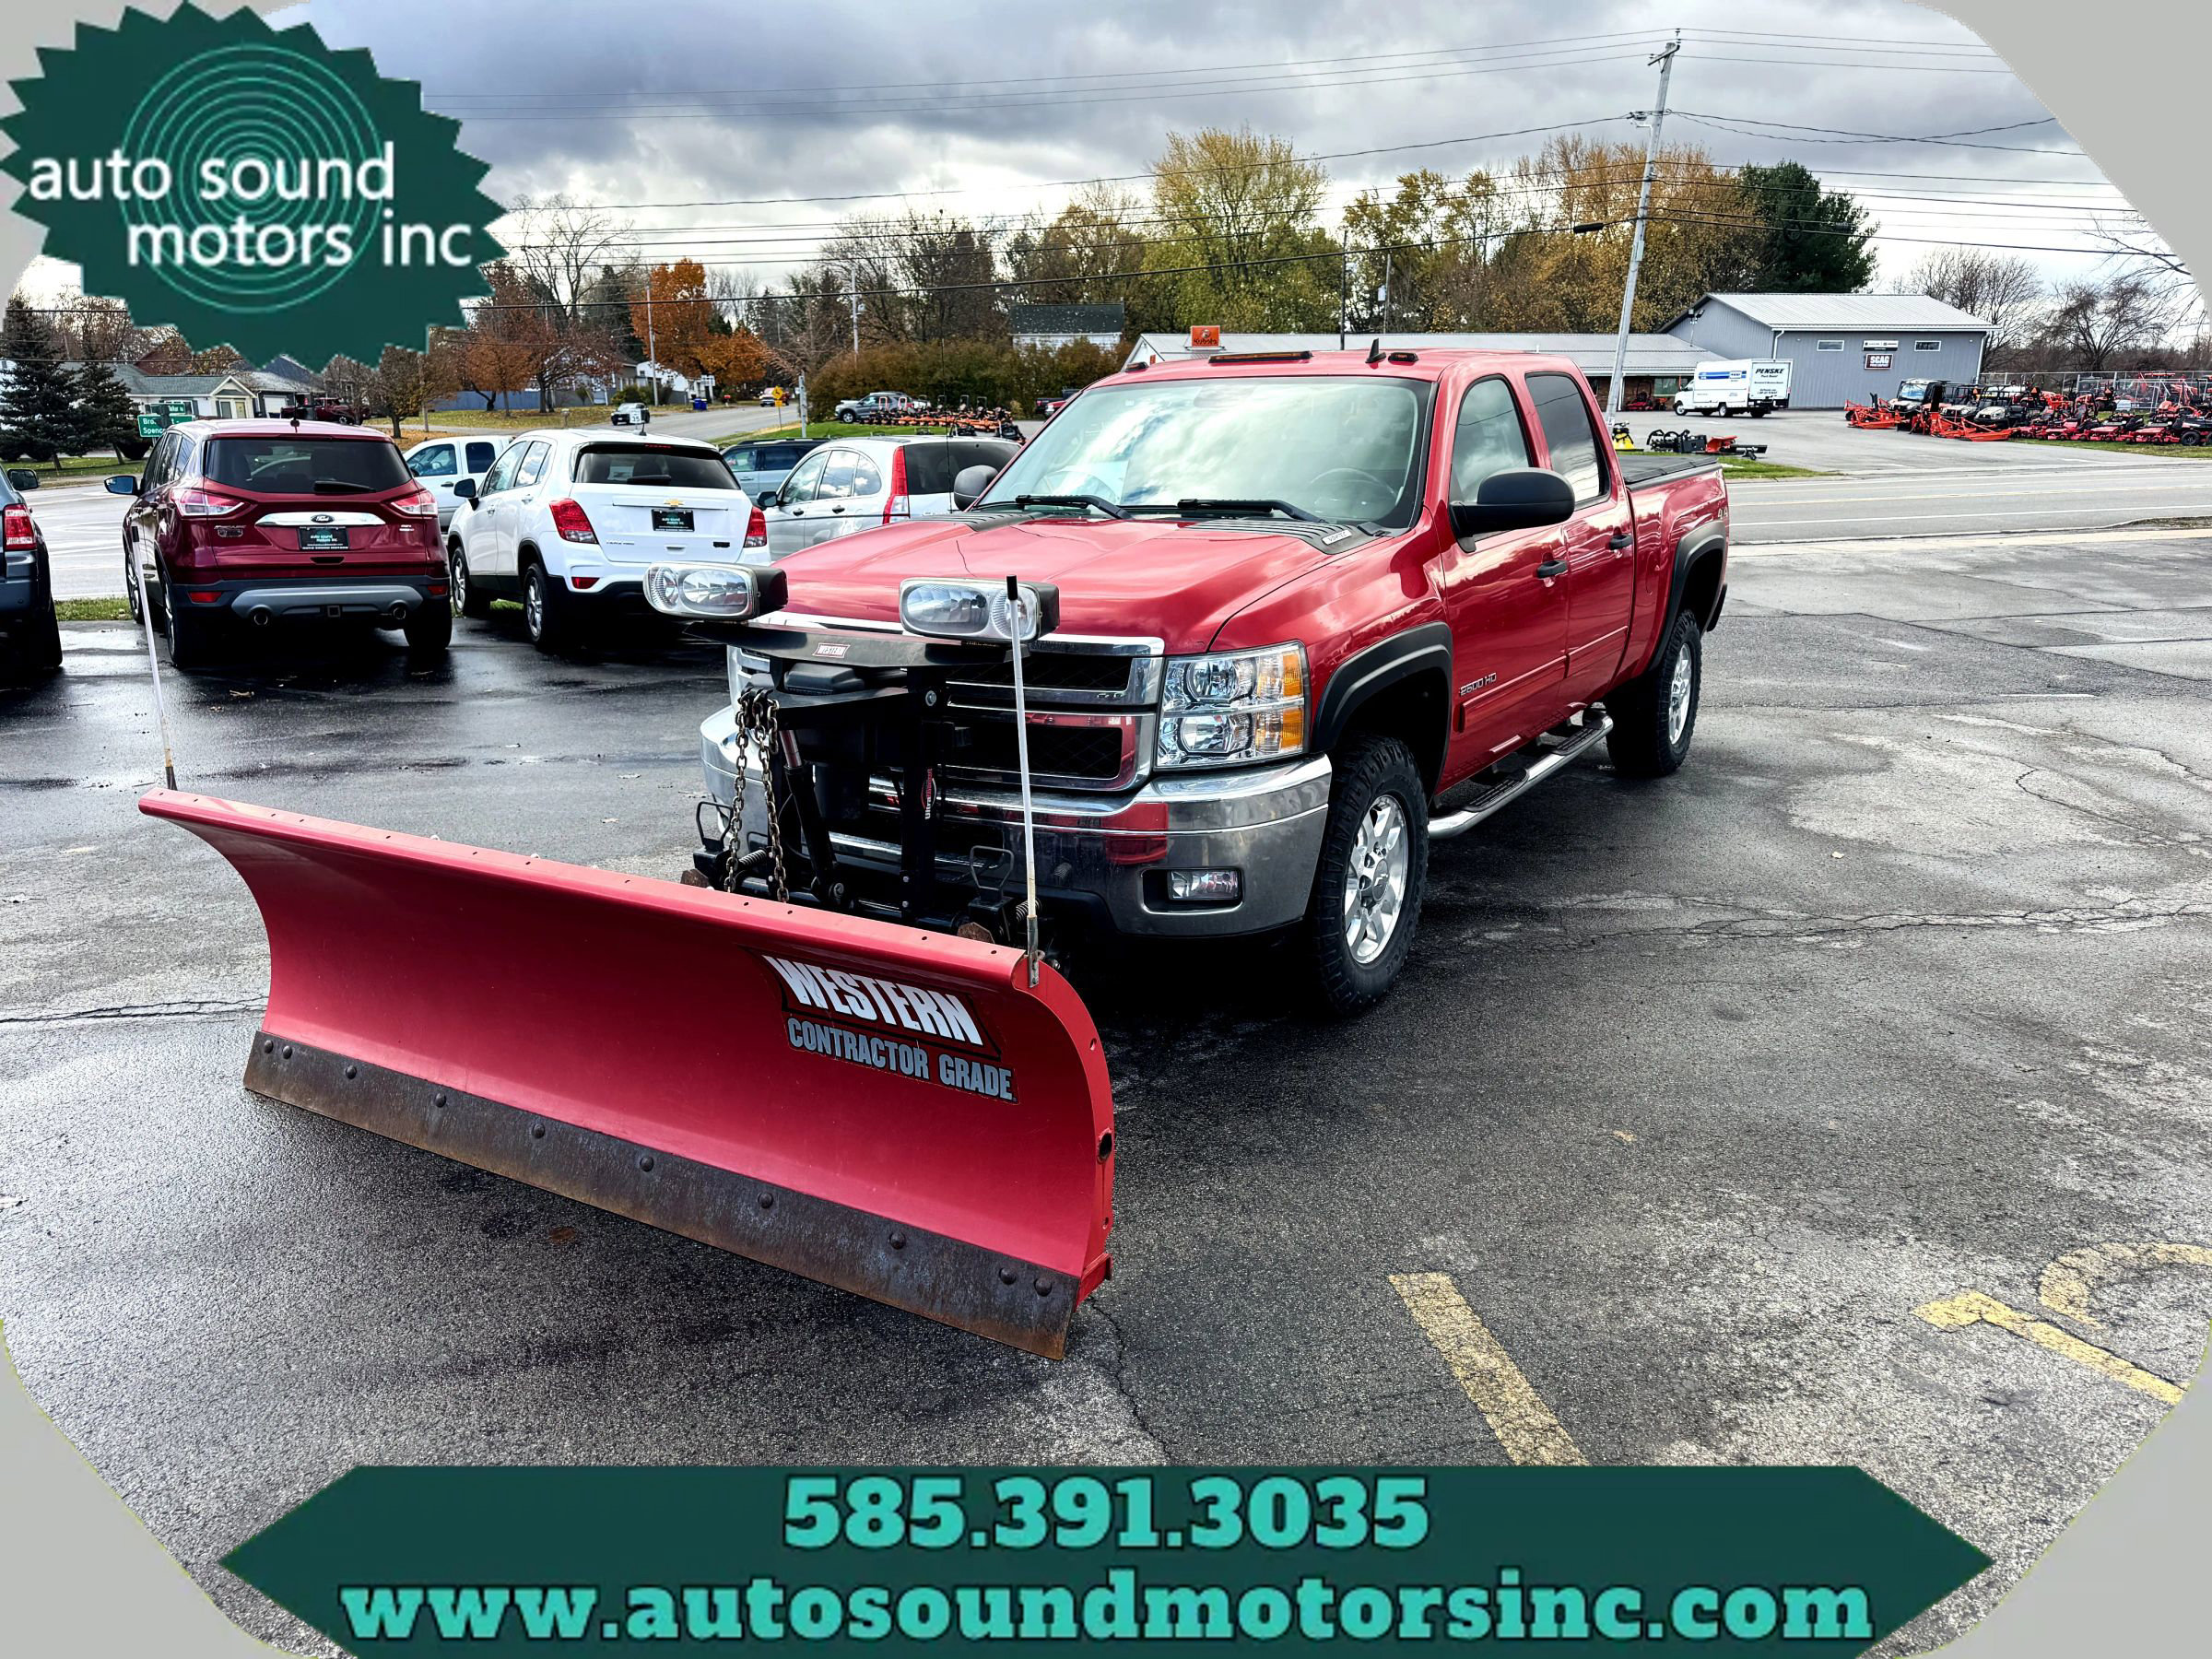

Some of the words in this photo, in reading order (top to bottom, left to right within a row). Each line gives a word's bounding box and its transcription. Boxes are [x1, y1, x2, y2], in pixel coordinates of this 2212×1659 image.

[1870, 355, 1890, 365] SCAG
[1484, 672, 1497, 685] HD
[761, 954, 983, 1046] WESTERN
[787, 1016, 930, 1080] CONTRACTOR
[938, 1053, 1015, 1100] GRADE
